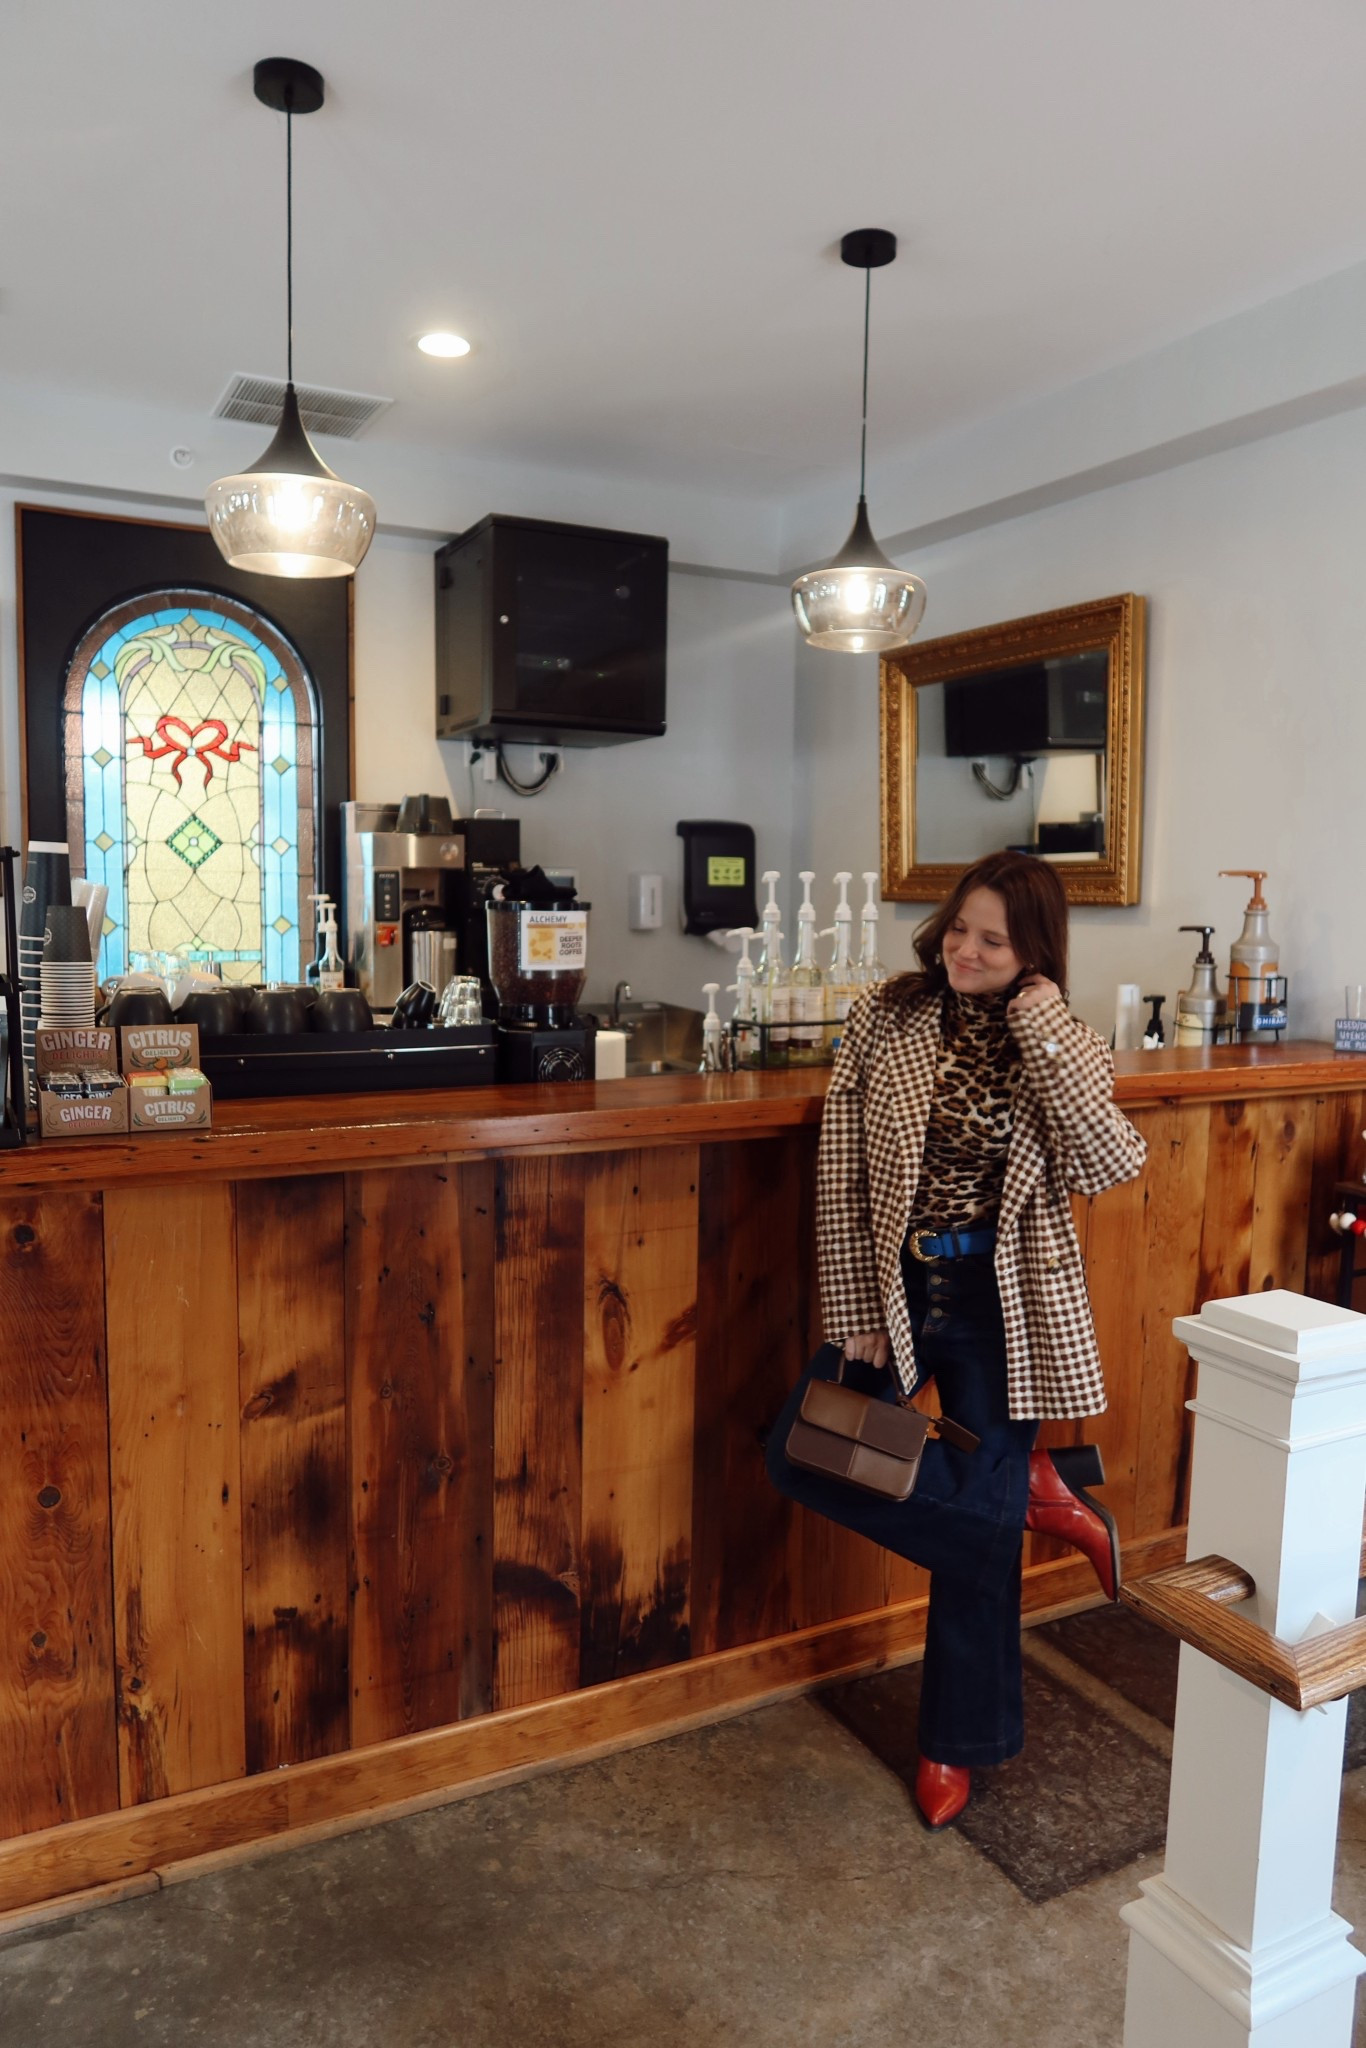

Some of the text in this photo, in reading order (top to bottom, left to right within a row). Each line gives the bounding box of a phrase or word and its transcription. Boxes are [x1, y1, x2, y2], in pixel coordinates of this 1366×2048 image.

[529, 915, 568, 923] ALCHEMY
[559, 948, 583, 956] COFFEE
[40, 1030, 112, 1051] GINGER
[127, 1029, 192, 1049] CITRUS
[52, 1051, 103, 1060] DELIGHTS
[144, 1049, 178, 1057] DELIGHTS
[60, 1105, 112, 1122] GINGER
[144, 1100, 196, 1117] CITRUS
